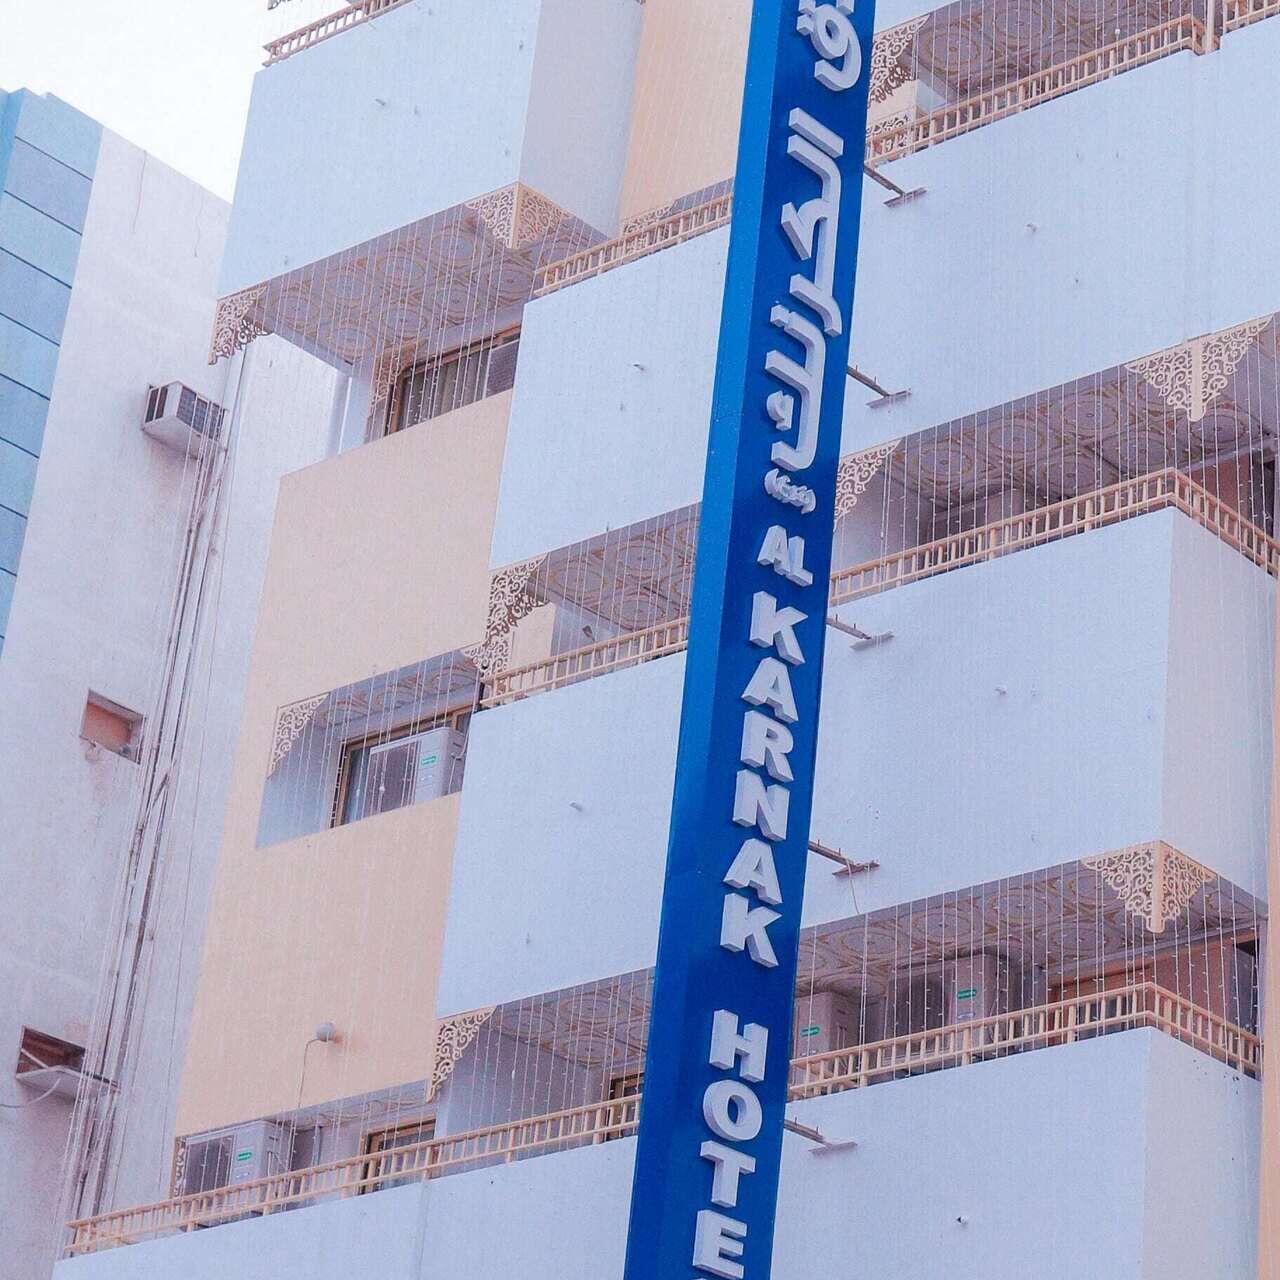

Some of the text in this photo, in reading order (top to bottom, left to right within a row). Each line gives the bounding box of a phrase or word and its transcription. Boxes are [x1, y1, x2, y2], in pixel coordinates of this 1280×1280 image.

[765, 107, 845, 472] الكرنك
[756, 524, 814, 587] AL
[719, 590, 809, 969] KARNAK
